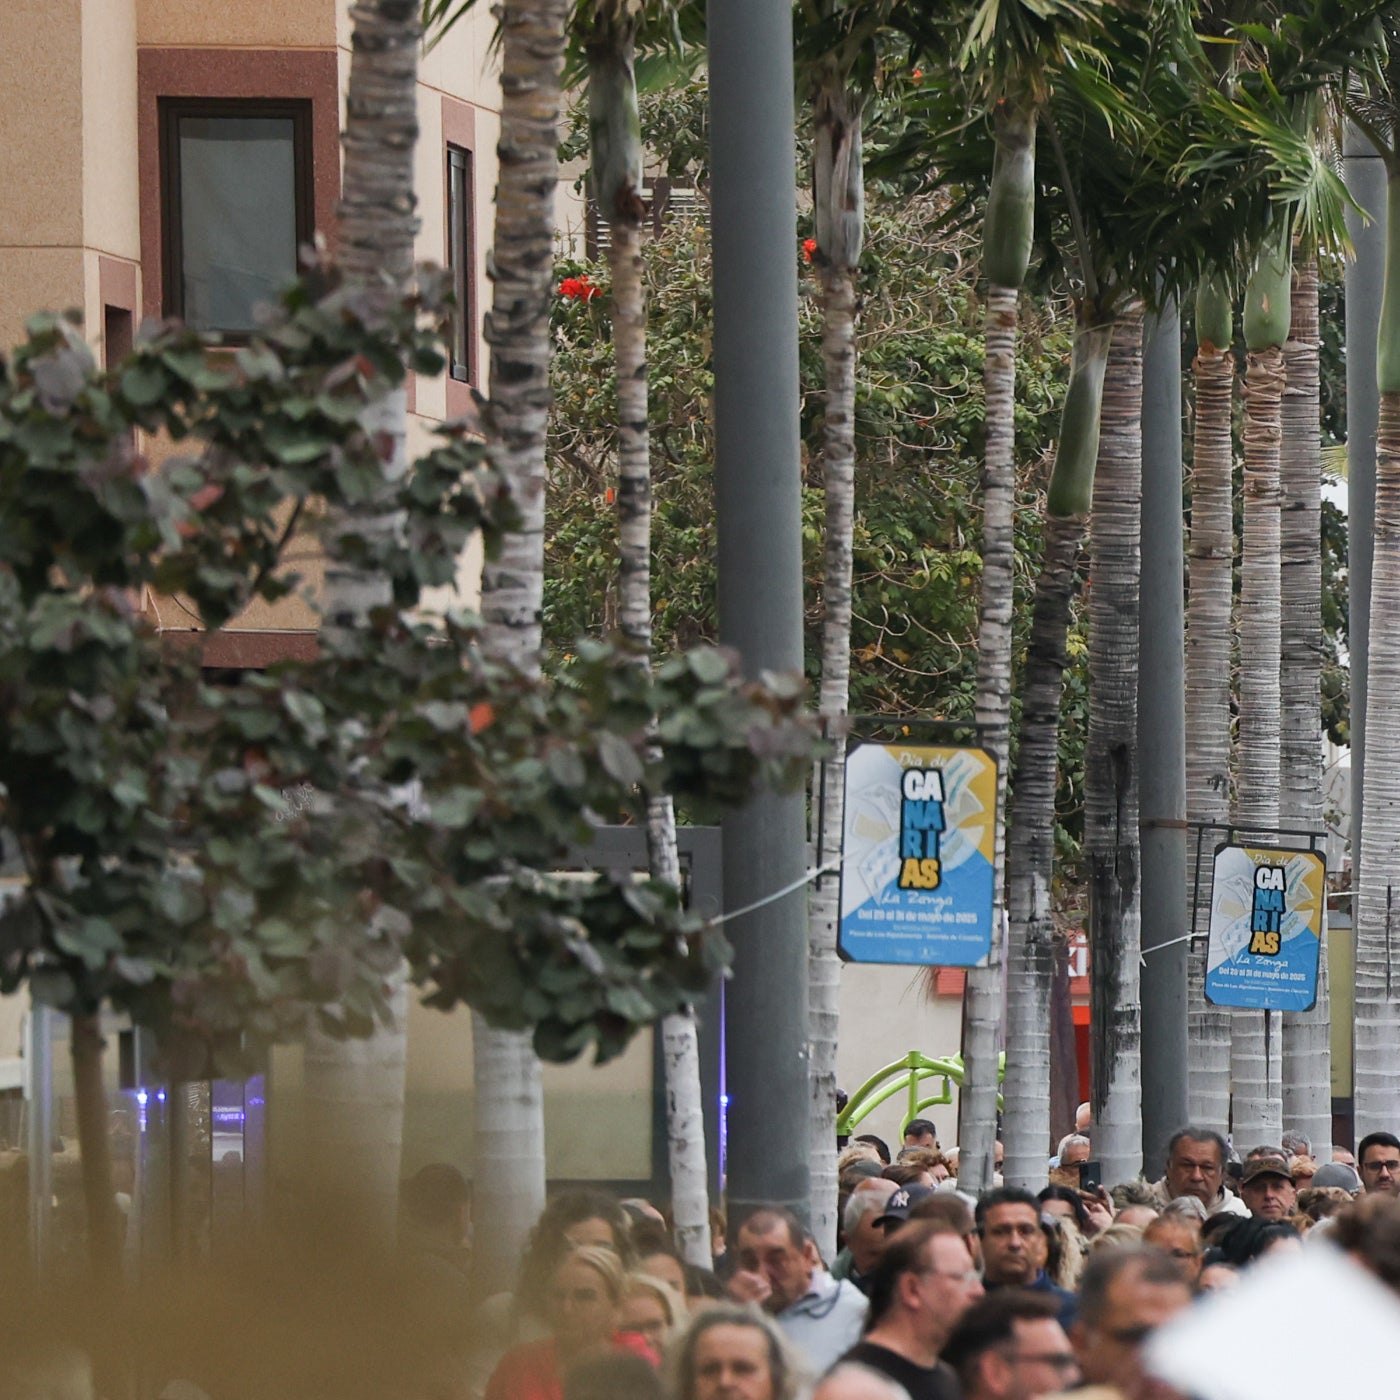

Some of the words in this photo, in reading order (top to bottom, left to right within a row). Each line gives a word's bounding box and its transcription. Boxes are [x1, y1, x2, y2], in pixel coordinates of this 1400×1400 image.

[903, 769, 944, 801] CA
[903, 801, 943, 830] NA
[903, 829, 937, 858] RI
[899, 857, 940, 889] AS
[1256, 867, 1284, 890] CA
[1255, 889, 1284, 912] NA
[1253, 910, 1279, 932] RI
[1250, 931, 1280, 954] AS
